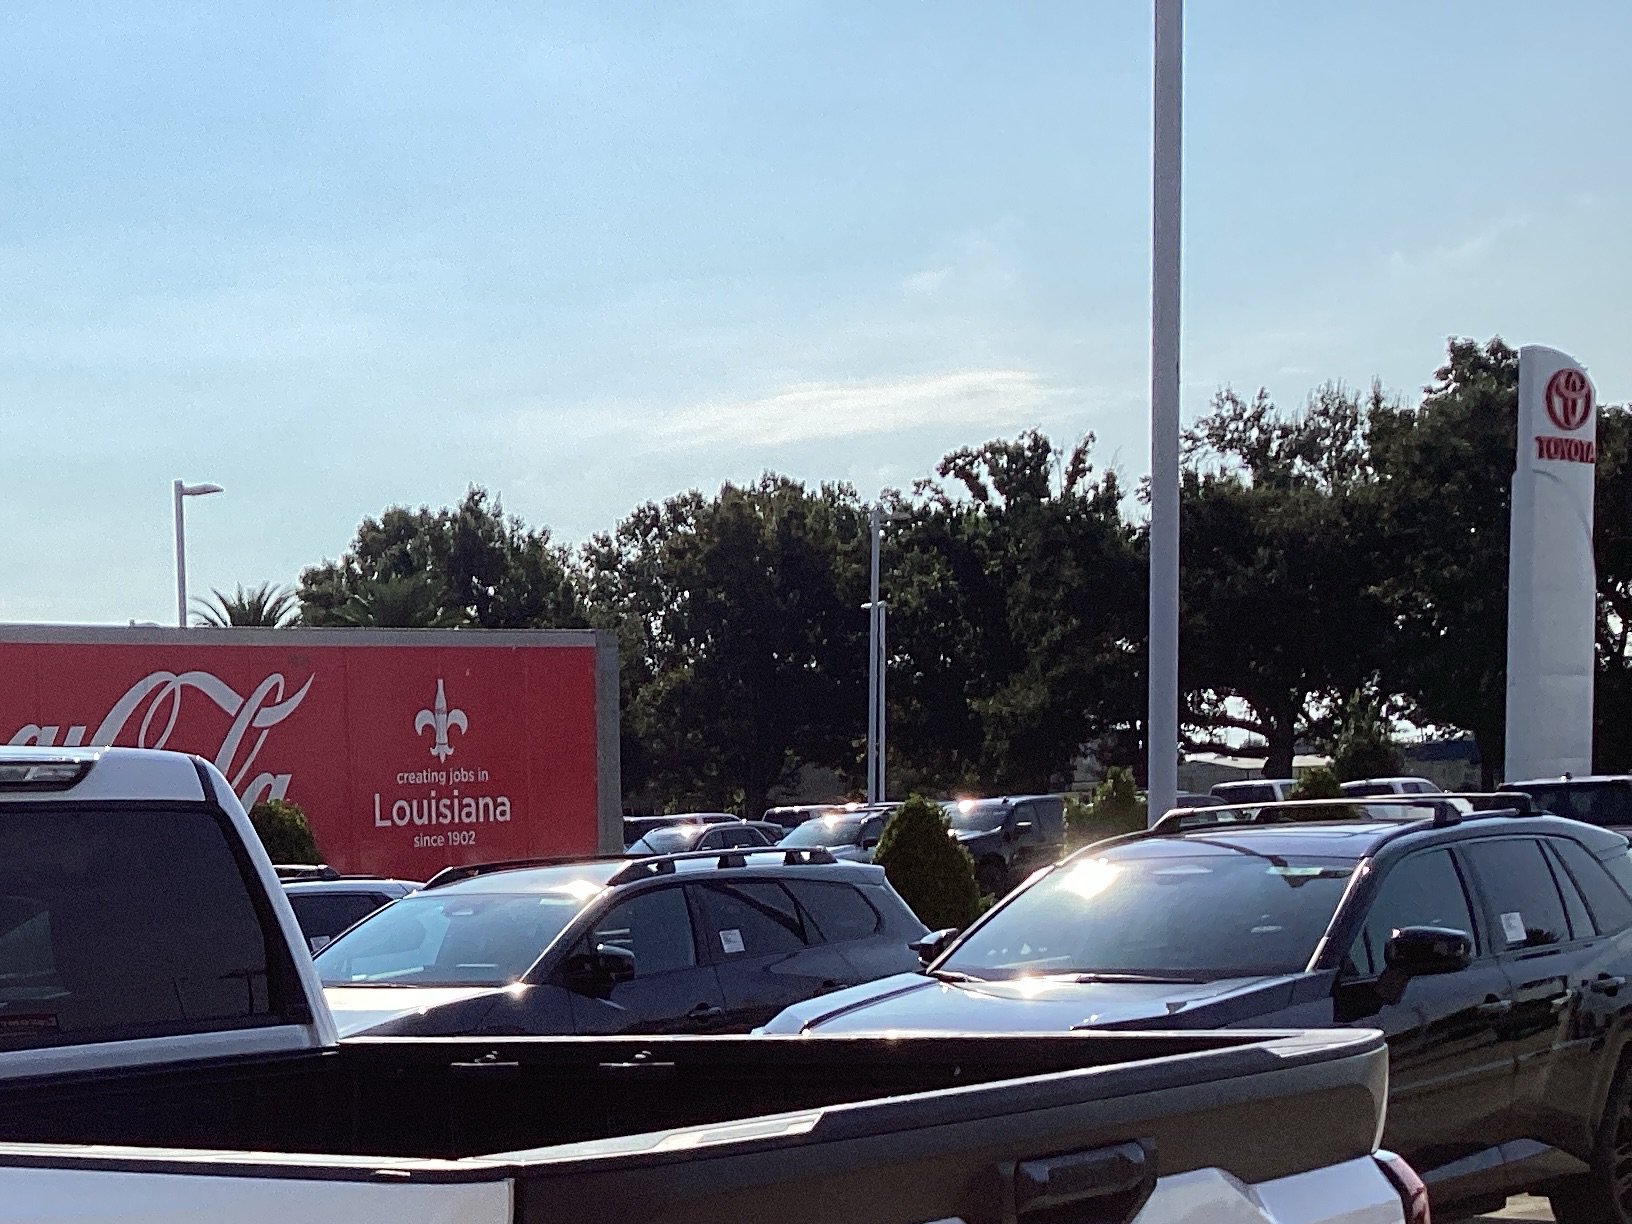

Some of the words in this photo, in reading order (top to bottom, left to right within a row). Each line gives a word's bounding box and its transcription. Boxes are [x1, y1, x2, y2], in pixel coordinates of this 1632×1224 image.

[1535, 436, 1596, 464] TOYOTA
[397, 768, 447, 785] creating
[449, 767, 475, 785] jobs
[478, 767, 489, 782] in
[374, 789, 511, 827] Louisiana
[413, 832, 445, 847] since
[447, 830, 476, 845] 1902
